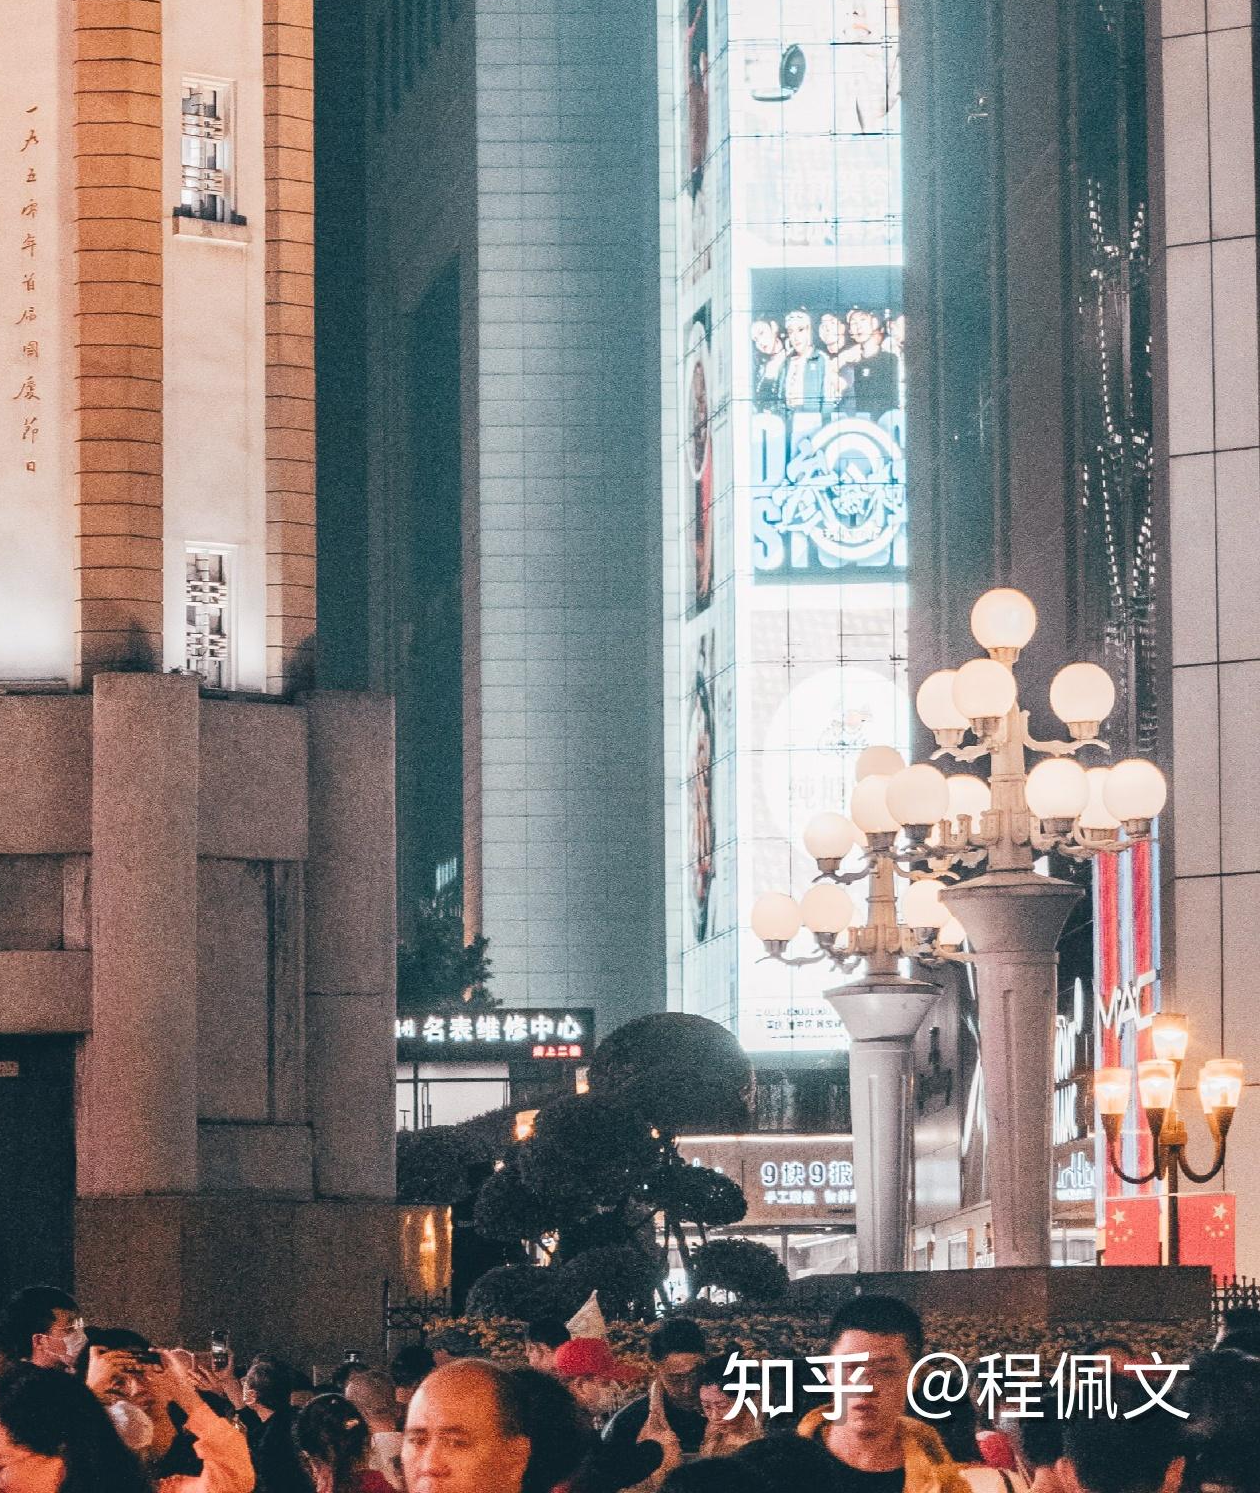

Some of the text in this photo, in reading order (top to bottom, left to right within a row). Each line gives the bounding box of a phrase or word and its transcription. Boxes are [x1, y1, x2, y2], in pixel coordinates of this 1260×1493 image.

[422, 1013, 583, 1043] 名表维修中心
